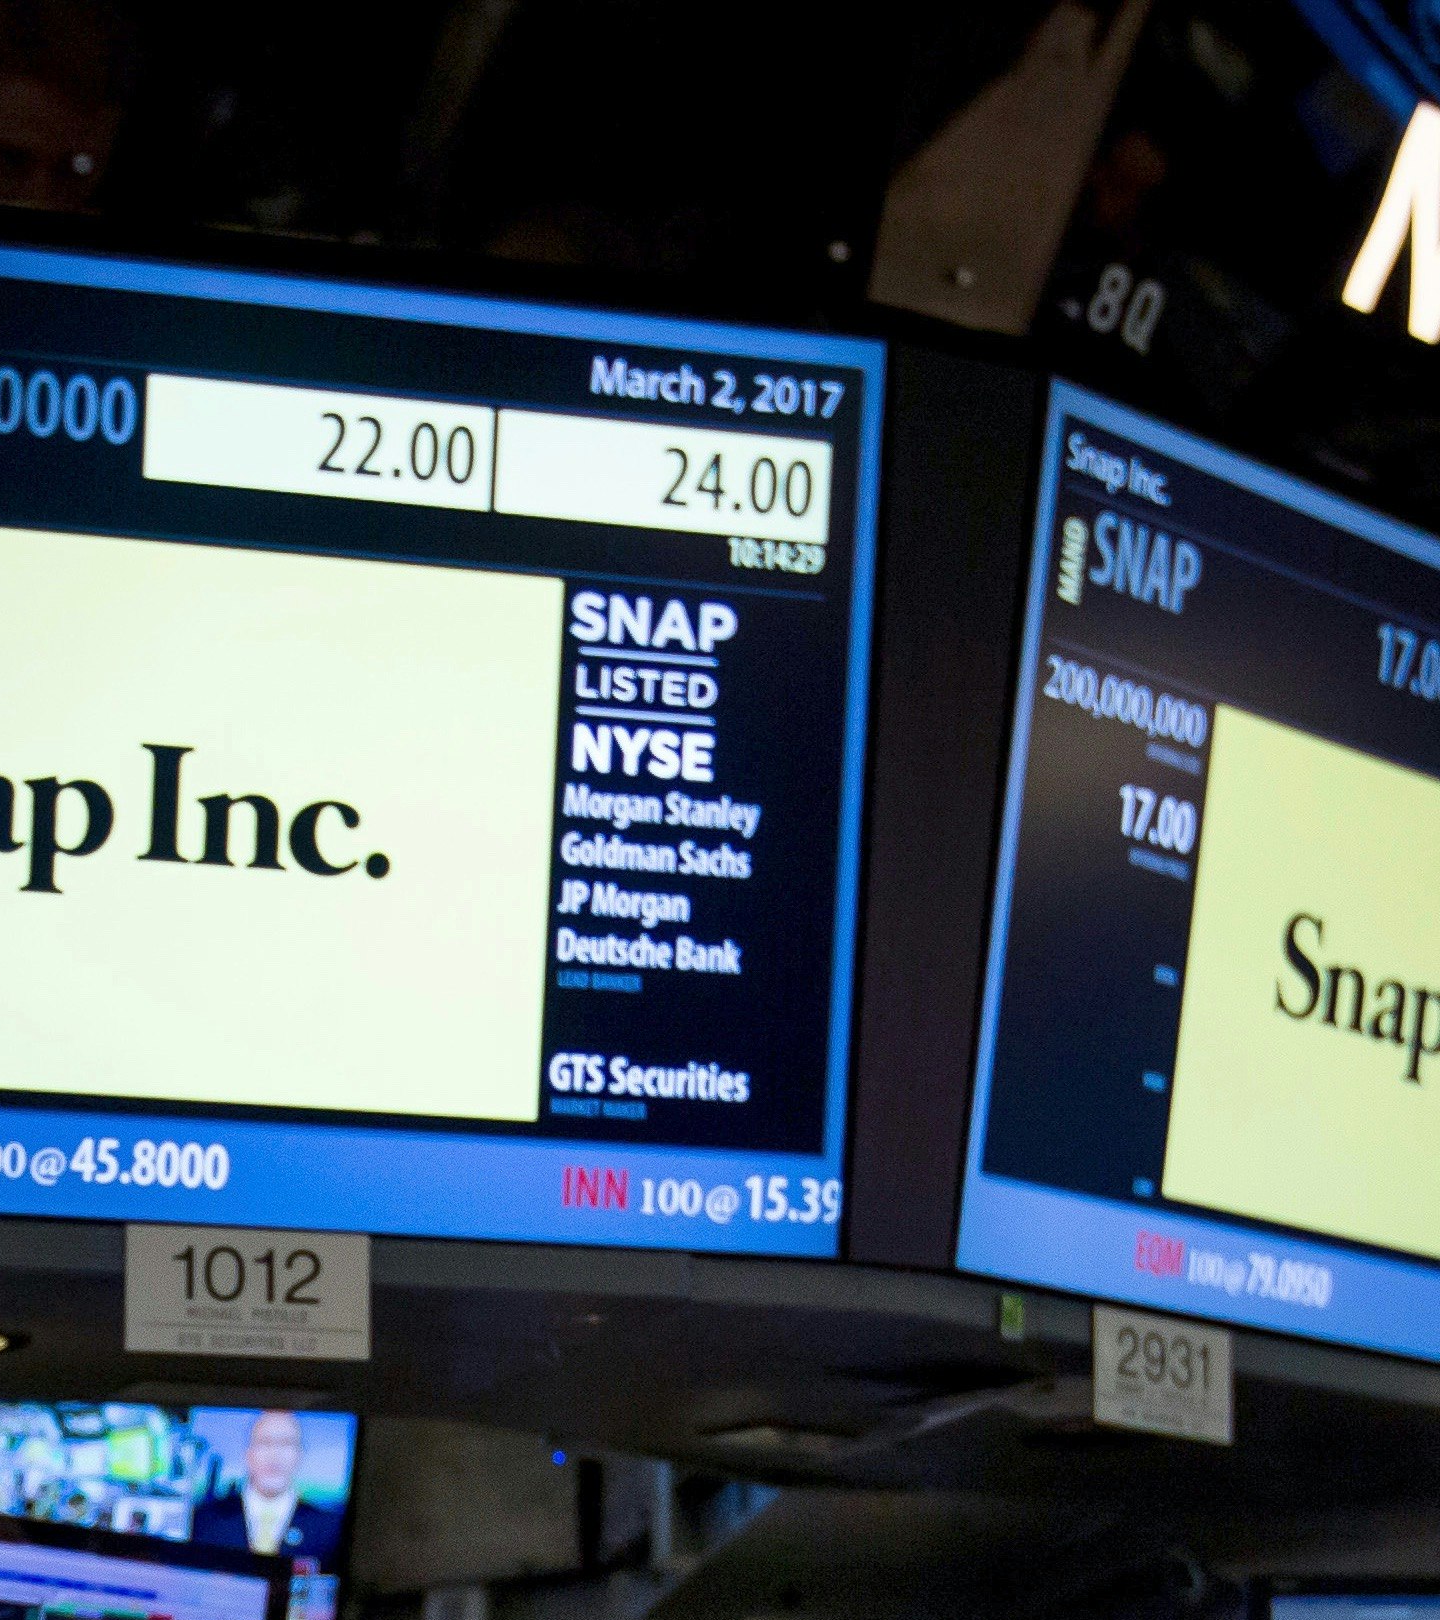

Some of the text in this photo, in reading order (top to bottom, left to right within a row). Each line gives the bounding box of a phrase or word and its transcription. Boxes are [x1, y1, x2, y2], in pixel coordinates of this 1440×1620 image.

[589, 355, 844, 420] March 2, 2017
[317, 411, 475, 486] 22.00
[1065, 431, 1172, 508] Snap Inc.
[661, 446, 814, 519] 24.00
[1089, 510, 1204, 615] SNAP
[569, 590, 740, 654] SNAP
[575, 663, 719, 710] LISTED
[1043, 653, 1208, 749] 200,000,000
[571, 721, 716, 784] NYSE
[135, 742, 392, 881] Inc.
[562, 783, 762, 839] Morgan Stanley
[1119, 782, 1196, 856] 17.00
[560, 830, 752, 880] Goldman Sachs
[557, 879, 691, 929] JP Morgan
[556, 927, 742, 975] Deutsche Bank
[548, 1052, 751, 1103] GTS Securities
[561, 1165, 630, 1210] INN
[173, 1243, 322, 1306] 1012
[1118, 1327, 1211, 1390] 2931
